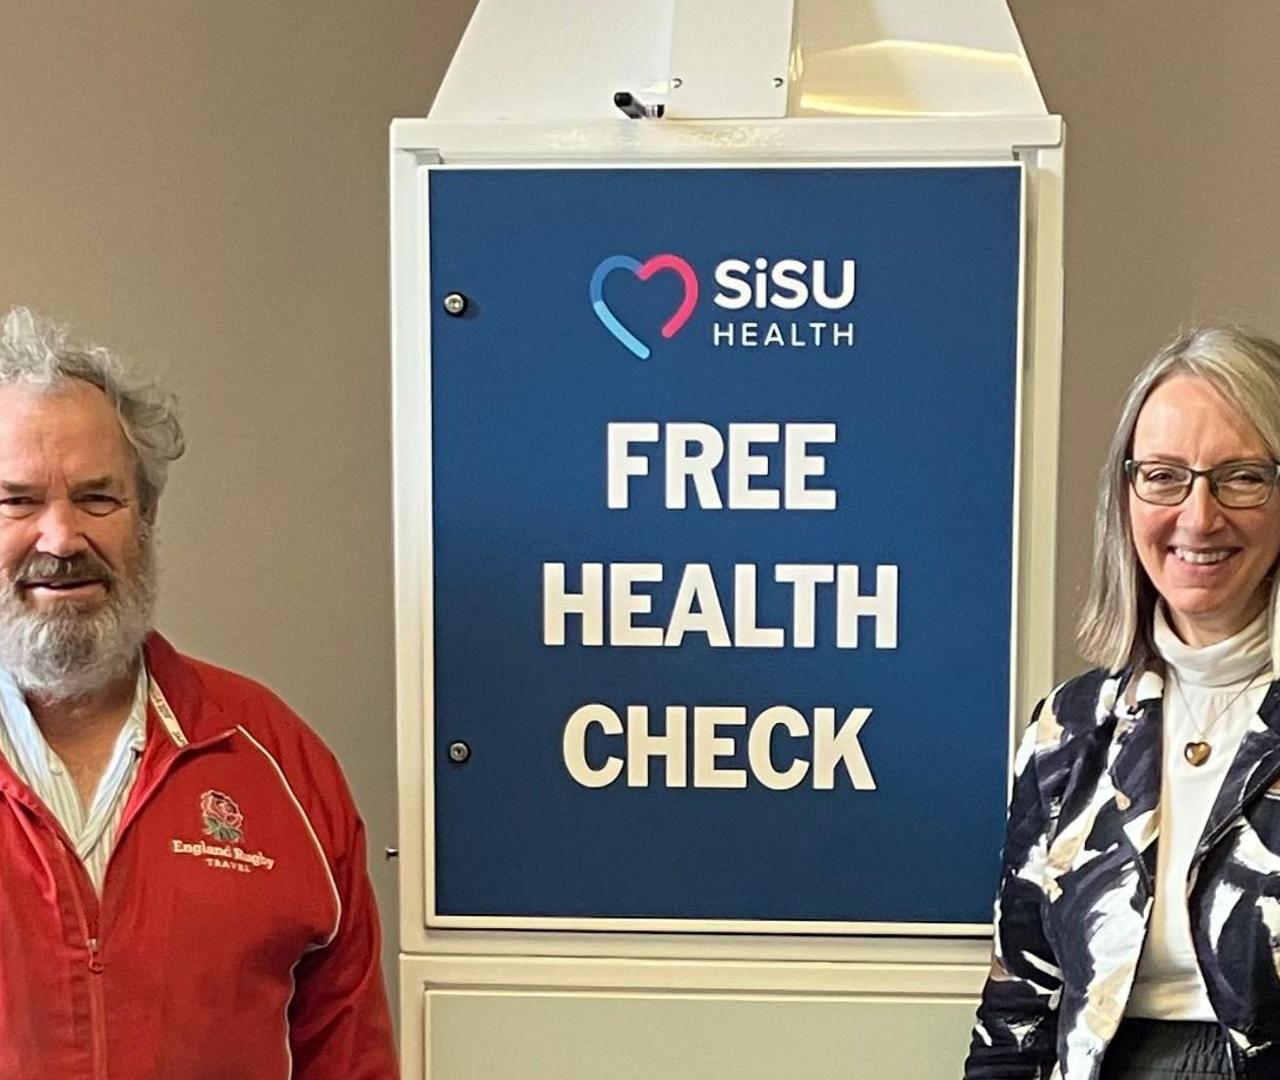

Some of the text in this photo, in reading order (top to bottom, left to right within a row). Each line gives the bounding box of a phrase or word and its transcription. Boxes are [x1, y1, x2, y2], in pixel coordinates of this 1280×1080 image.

[713, 257, 855, 309] SiSU
[713, 322, 853, 347] HEALTH
[608, 422, 836, 510] FREE
[543, 563, 898, 649] HEALTH
[563, 704, 876, 790] CHECK
[172, 839, 275, 870] England Rugby
[205, 858, 252, 873] TRAVEL
